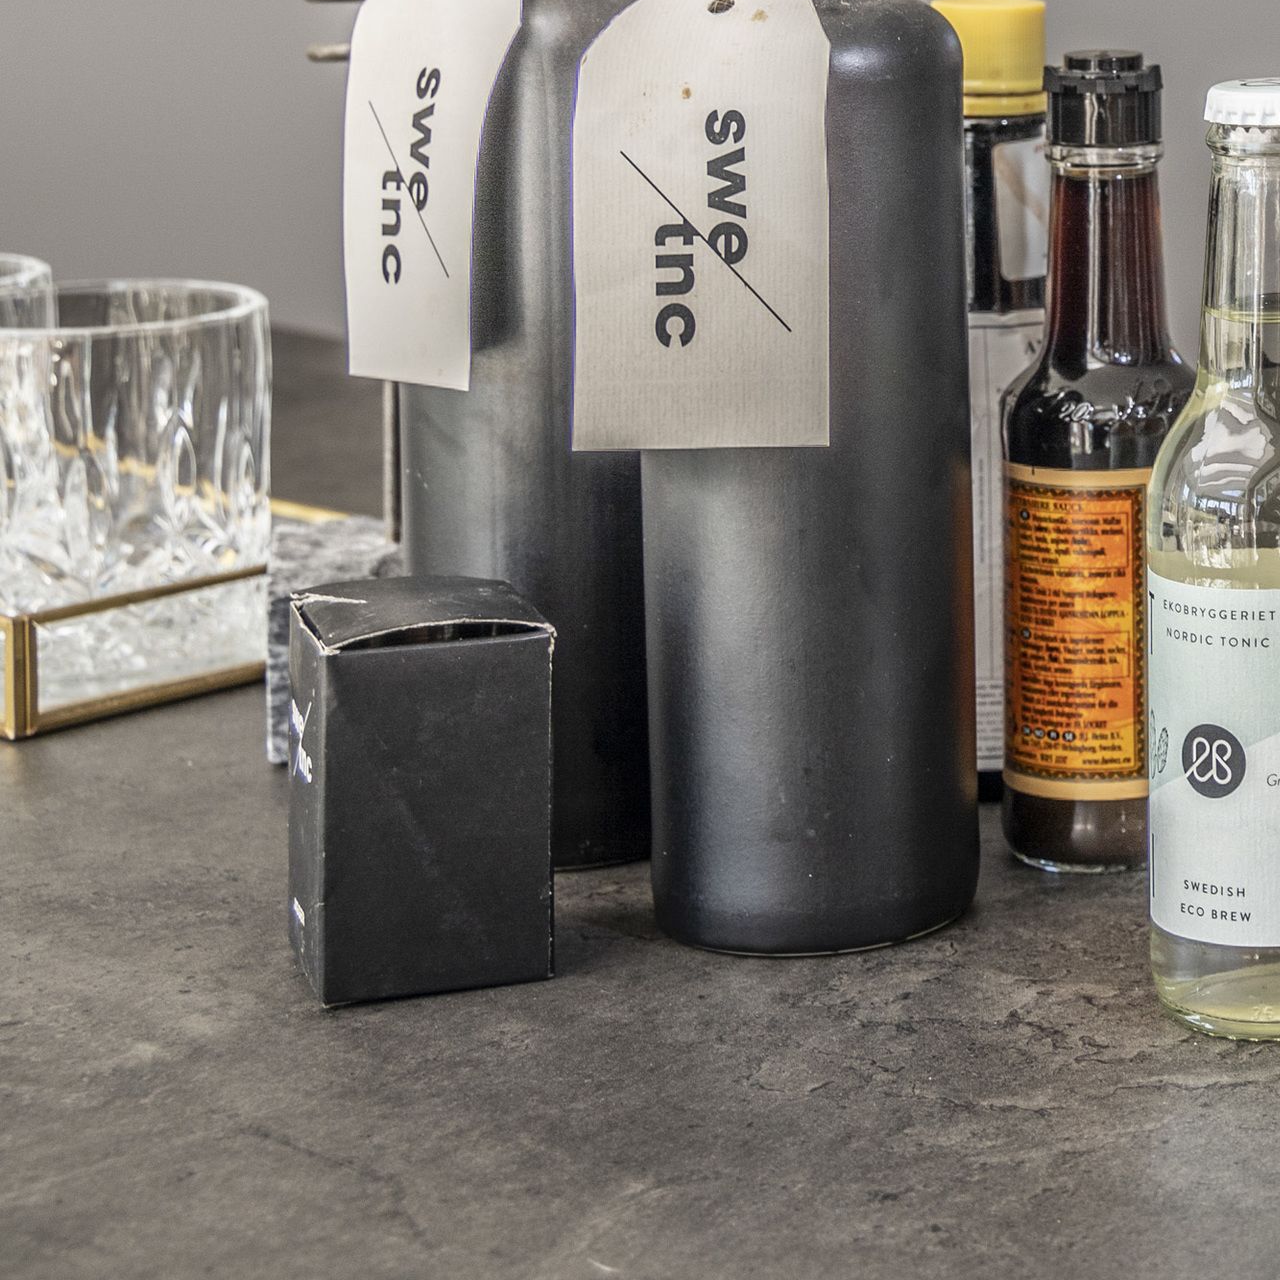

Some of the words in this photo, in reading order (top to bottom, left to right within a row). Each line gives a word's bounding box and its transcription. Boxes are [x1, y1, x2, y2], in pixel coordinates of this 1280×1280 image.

[409, 67, 441, 212] swe
[705, 109, 748, 265] swe
[382, 168, 402, 284] tnc
[655, 218, 697, 348] tnc
[1163, 599, 1276, 621] EKOBRYGGERIET
[1166, 627, 1213, 646] NORDIC
[1220, 636, 1270, 648] TONIC
[1180, 902, 1205, 917] ECO
[1211, 909, 1251, 922] BREW
[1183, 879, 1246, 898] SWEDISH
